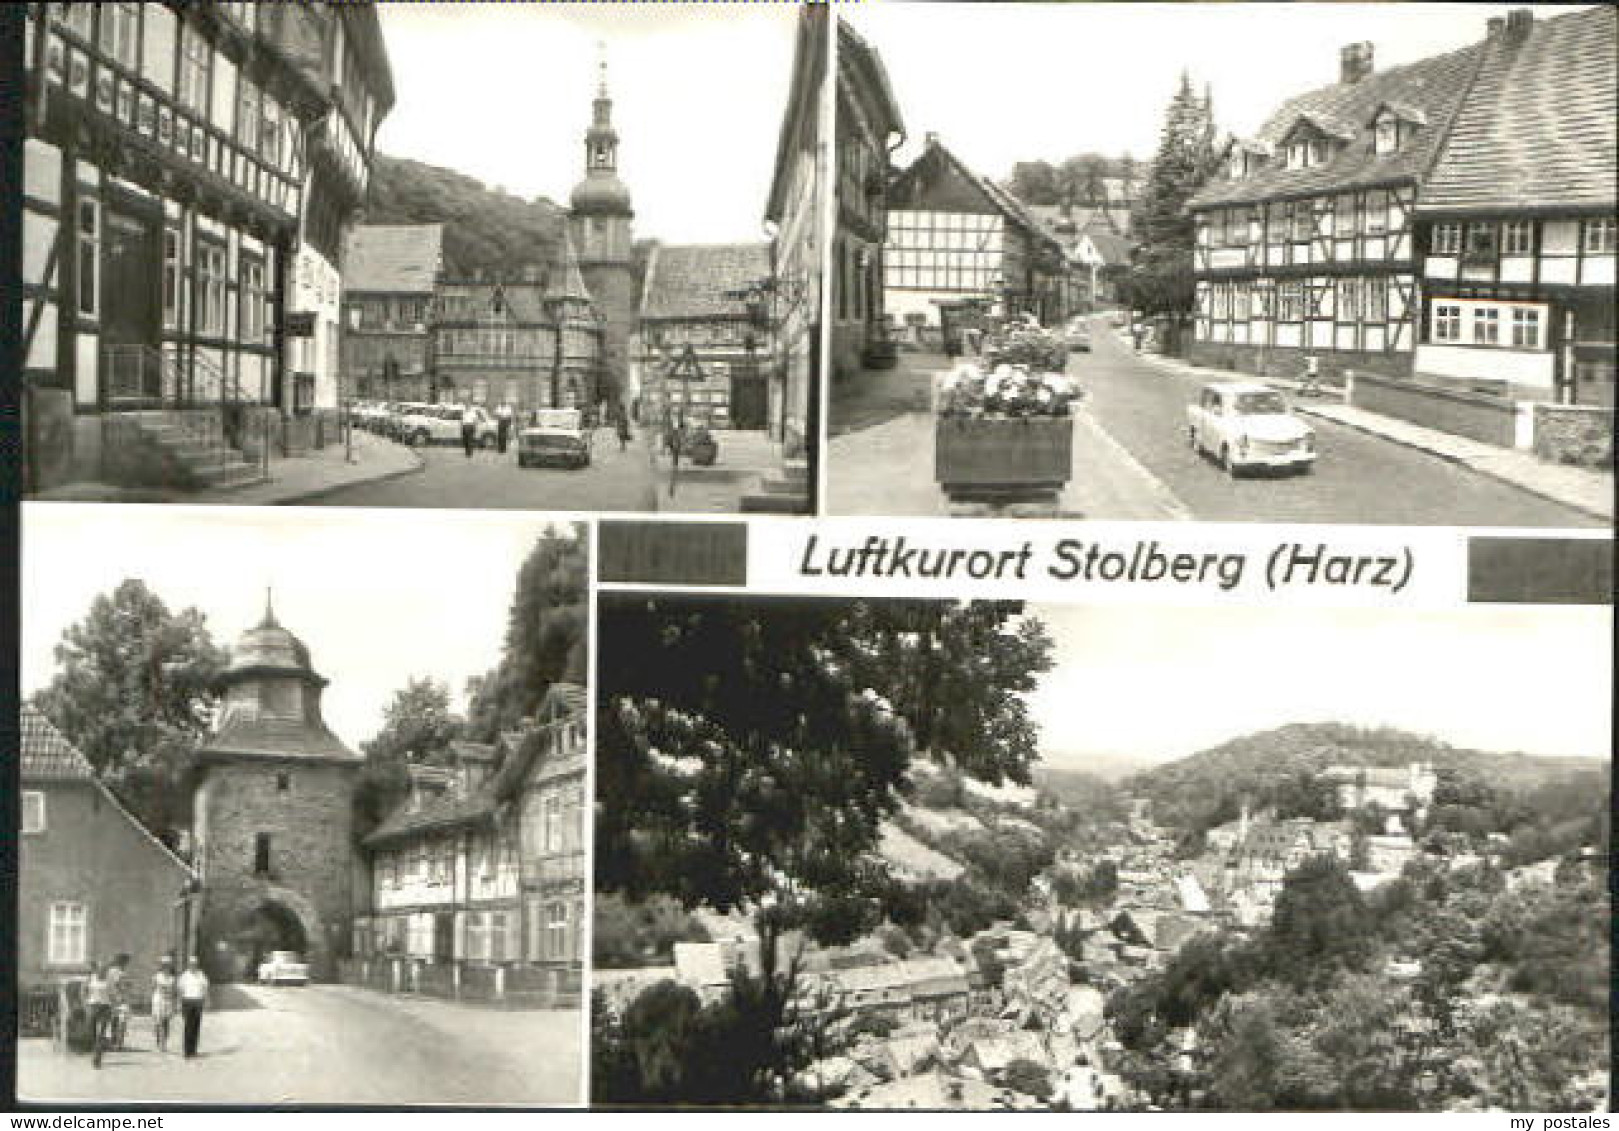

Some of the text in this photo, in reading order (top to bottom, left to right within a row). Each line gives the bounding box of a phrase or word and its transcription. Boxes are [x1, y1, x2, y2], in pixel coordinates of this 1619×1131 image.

[801, 535, 1412, 593] Luftkurort Stolberg (Harz)
